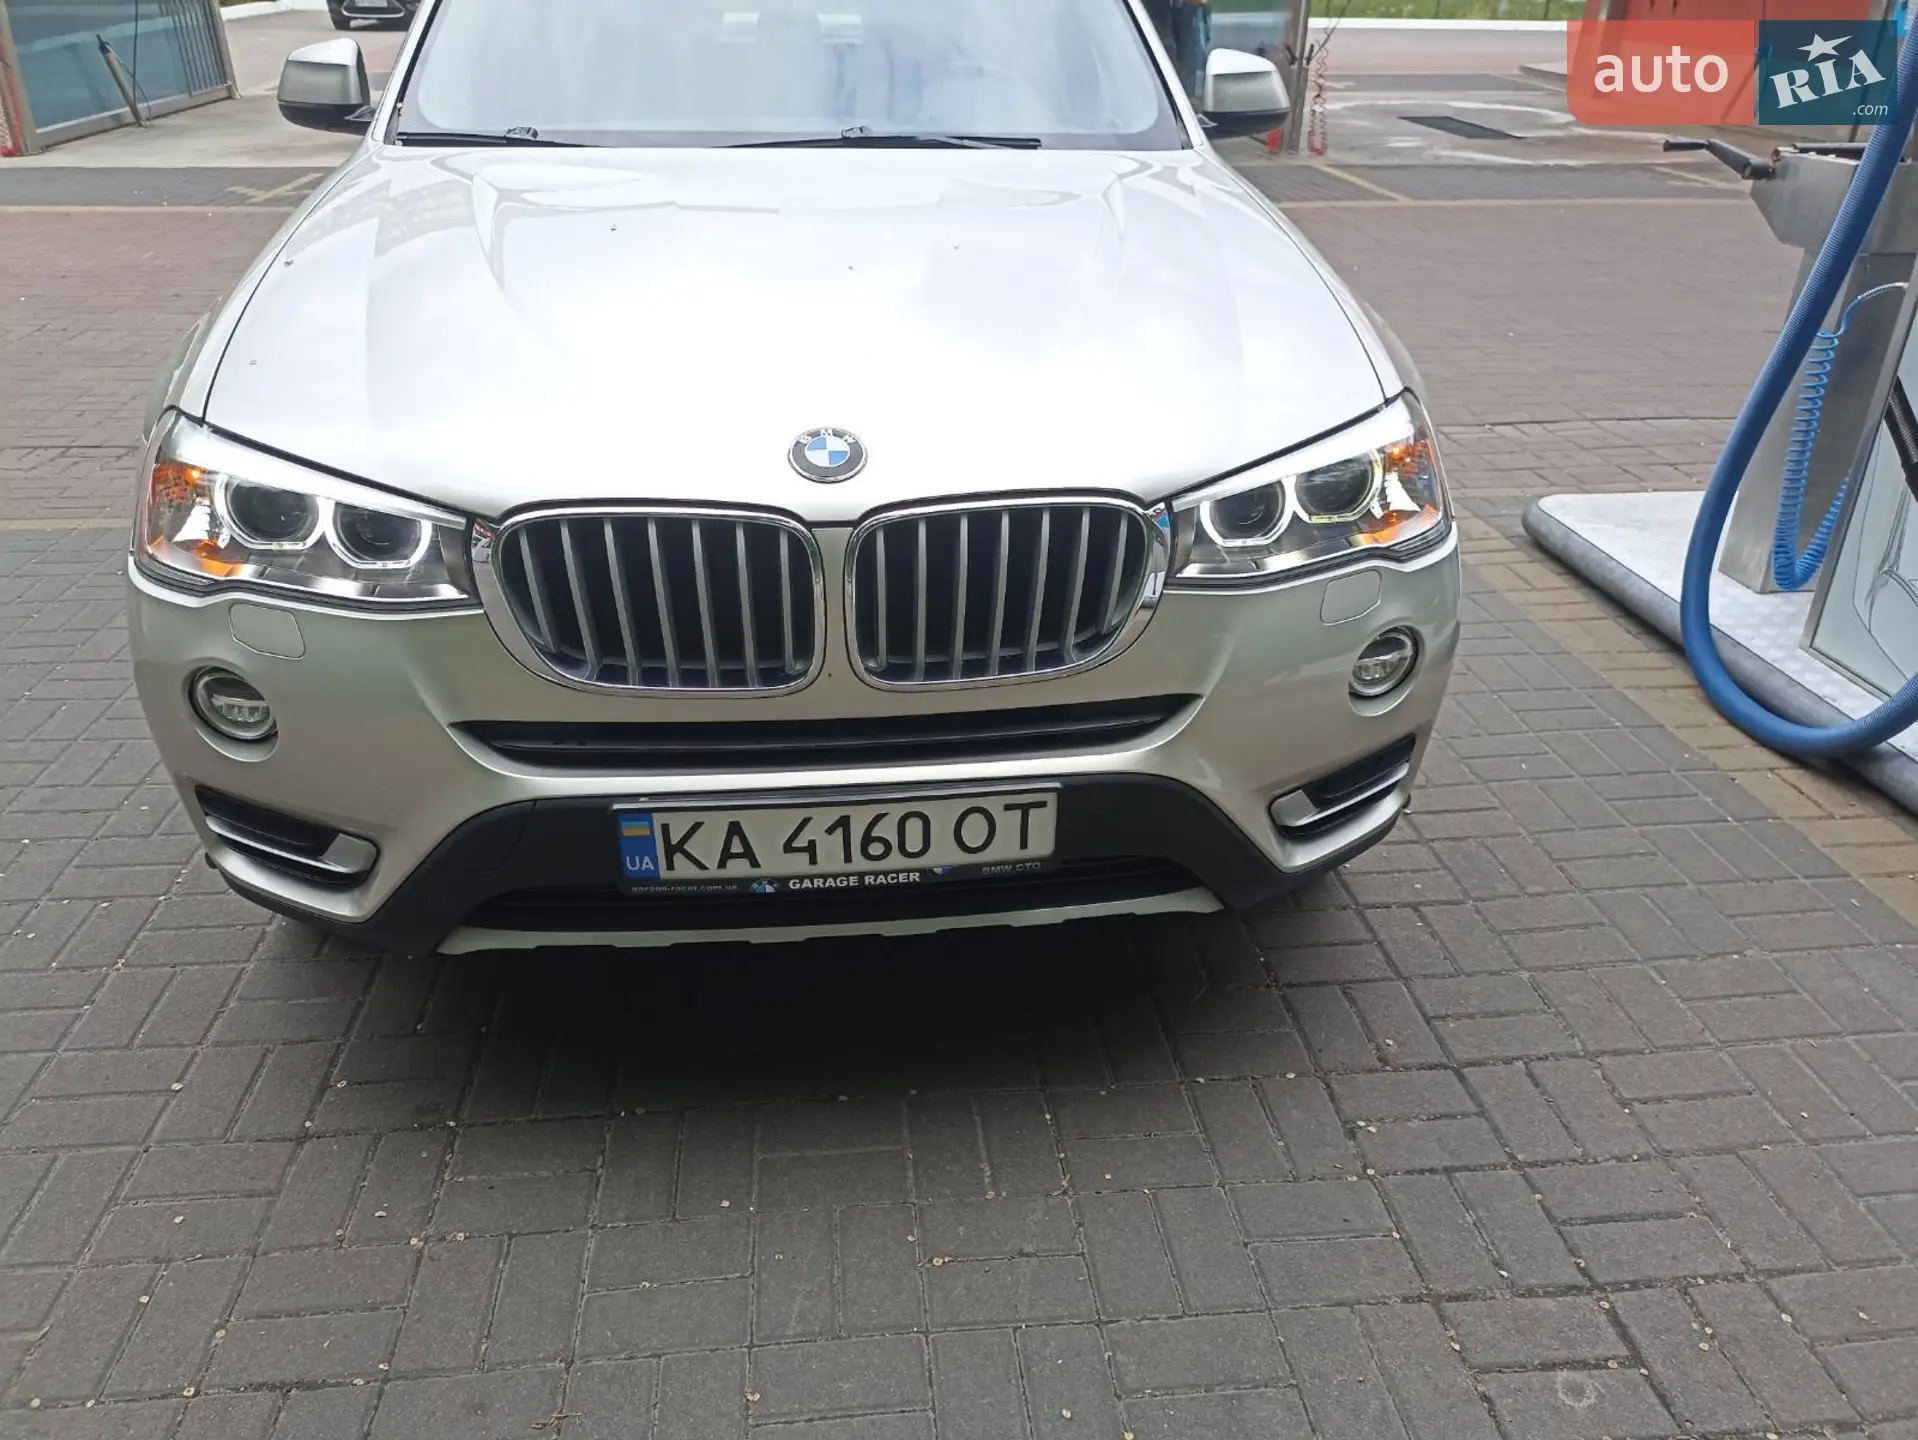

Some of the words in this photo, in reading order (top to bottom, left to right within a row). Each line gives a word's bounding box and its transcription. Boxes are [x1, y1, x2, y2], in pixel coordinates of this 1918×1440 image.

[660, 820, 762, 871] KA
[783, 812, 931, 866] 4160
[953, 800, 1048, 855] OT
[626, 856, 655, 871] UA
[788, 876, 860, 890] GARAGE
[864, 872, 921, 885] RACER
